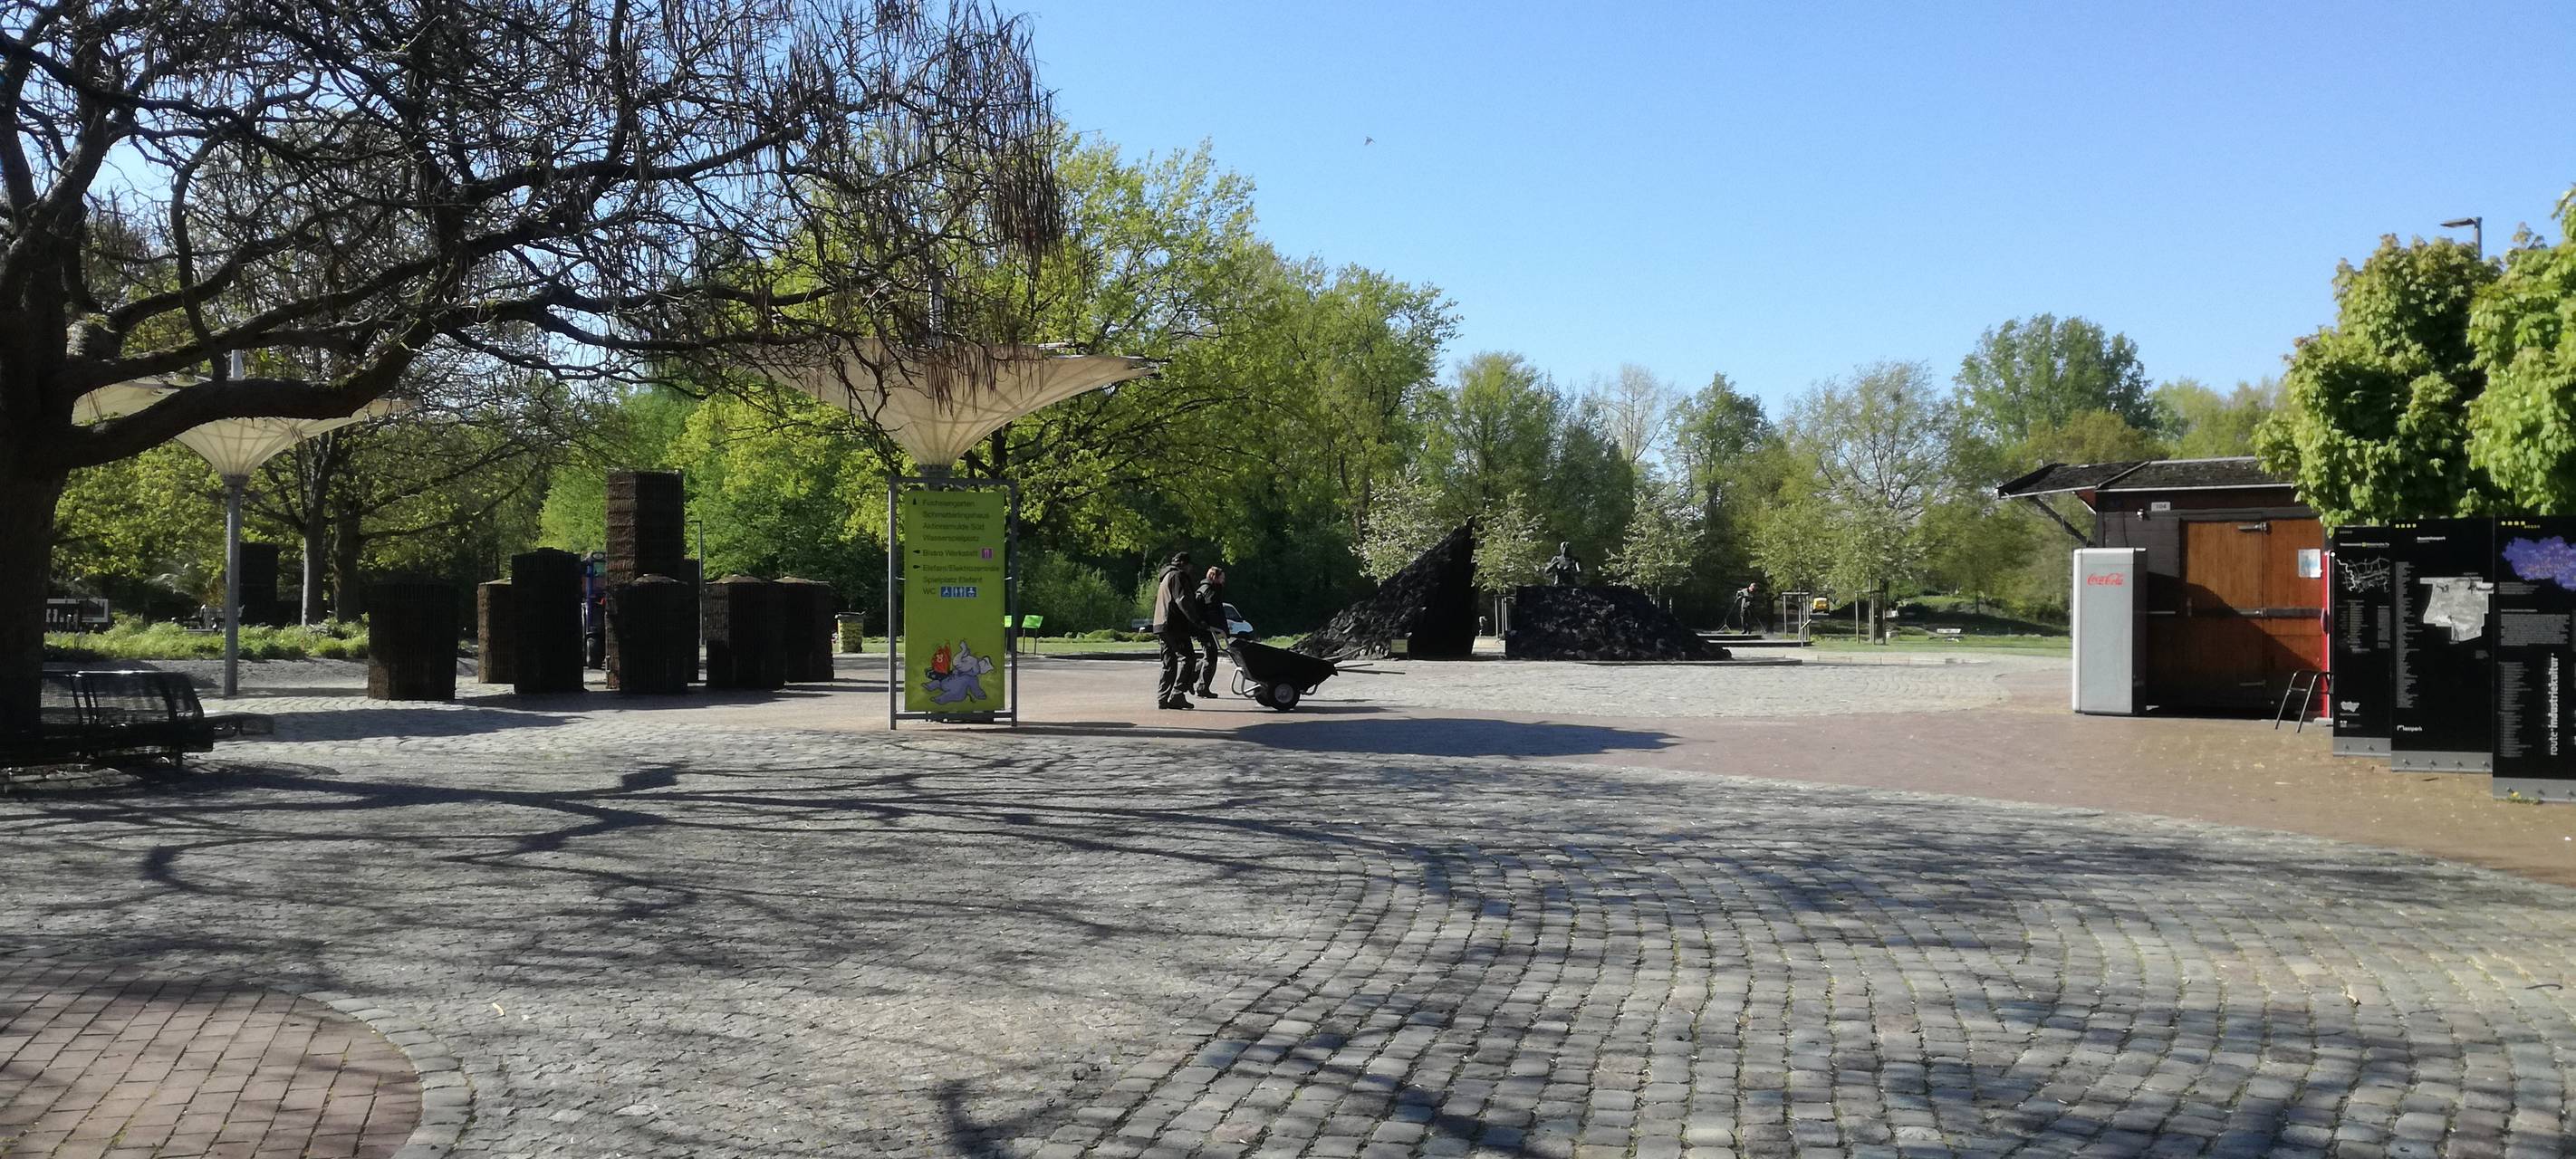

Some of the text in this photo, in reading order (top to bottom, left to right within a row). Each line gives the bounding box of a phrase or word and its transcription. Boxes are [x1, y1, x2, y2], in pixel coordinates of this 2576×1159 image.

[922, 511, 989, 520] Schmetterlingshaus
[922, 522, 985, 531] Aktionsmulde Süd
[922, 534, 979, 543] Wasserspielplatz
[922, 549, 978, 557] Bistro Werkstatt
[922, 576, 983, 585] Spielplatz Elefant
